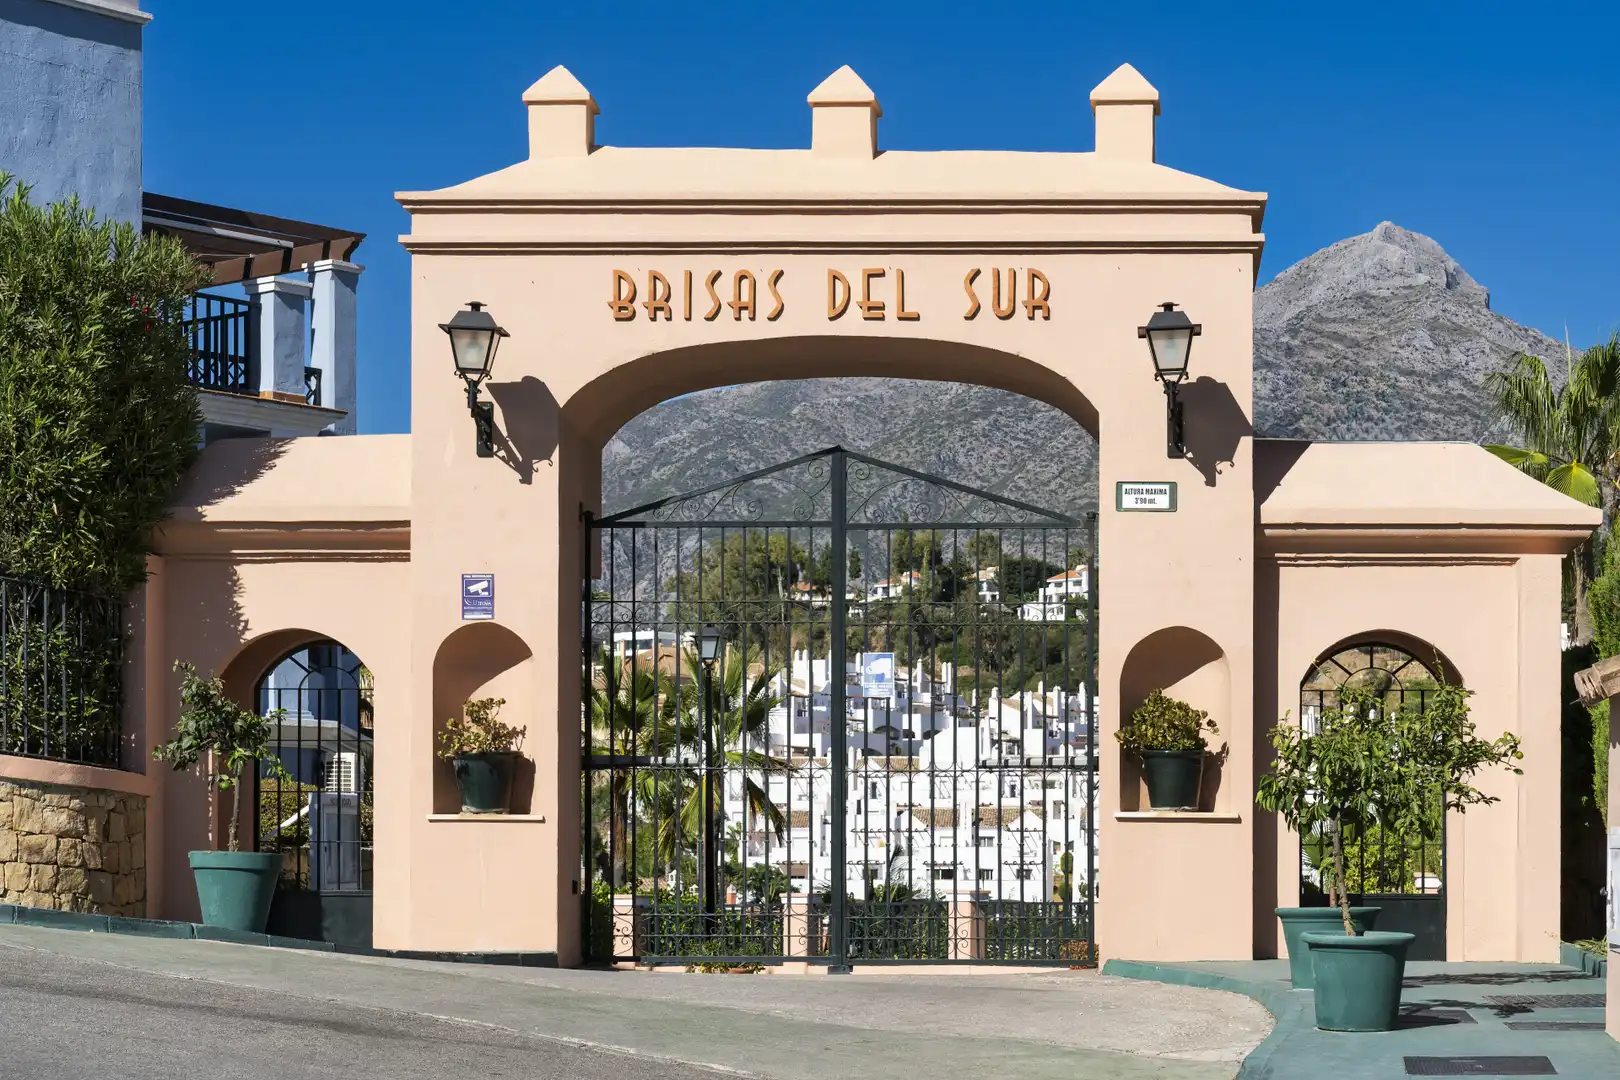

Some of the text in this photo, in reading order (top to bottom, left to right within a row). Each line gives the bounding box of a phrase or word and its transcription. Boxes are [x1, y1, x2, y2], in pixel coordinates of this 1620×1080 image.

[607, 268, 1052, 321] BRISAS DEL SUR
